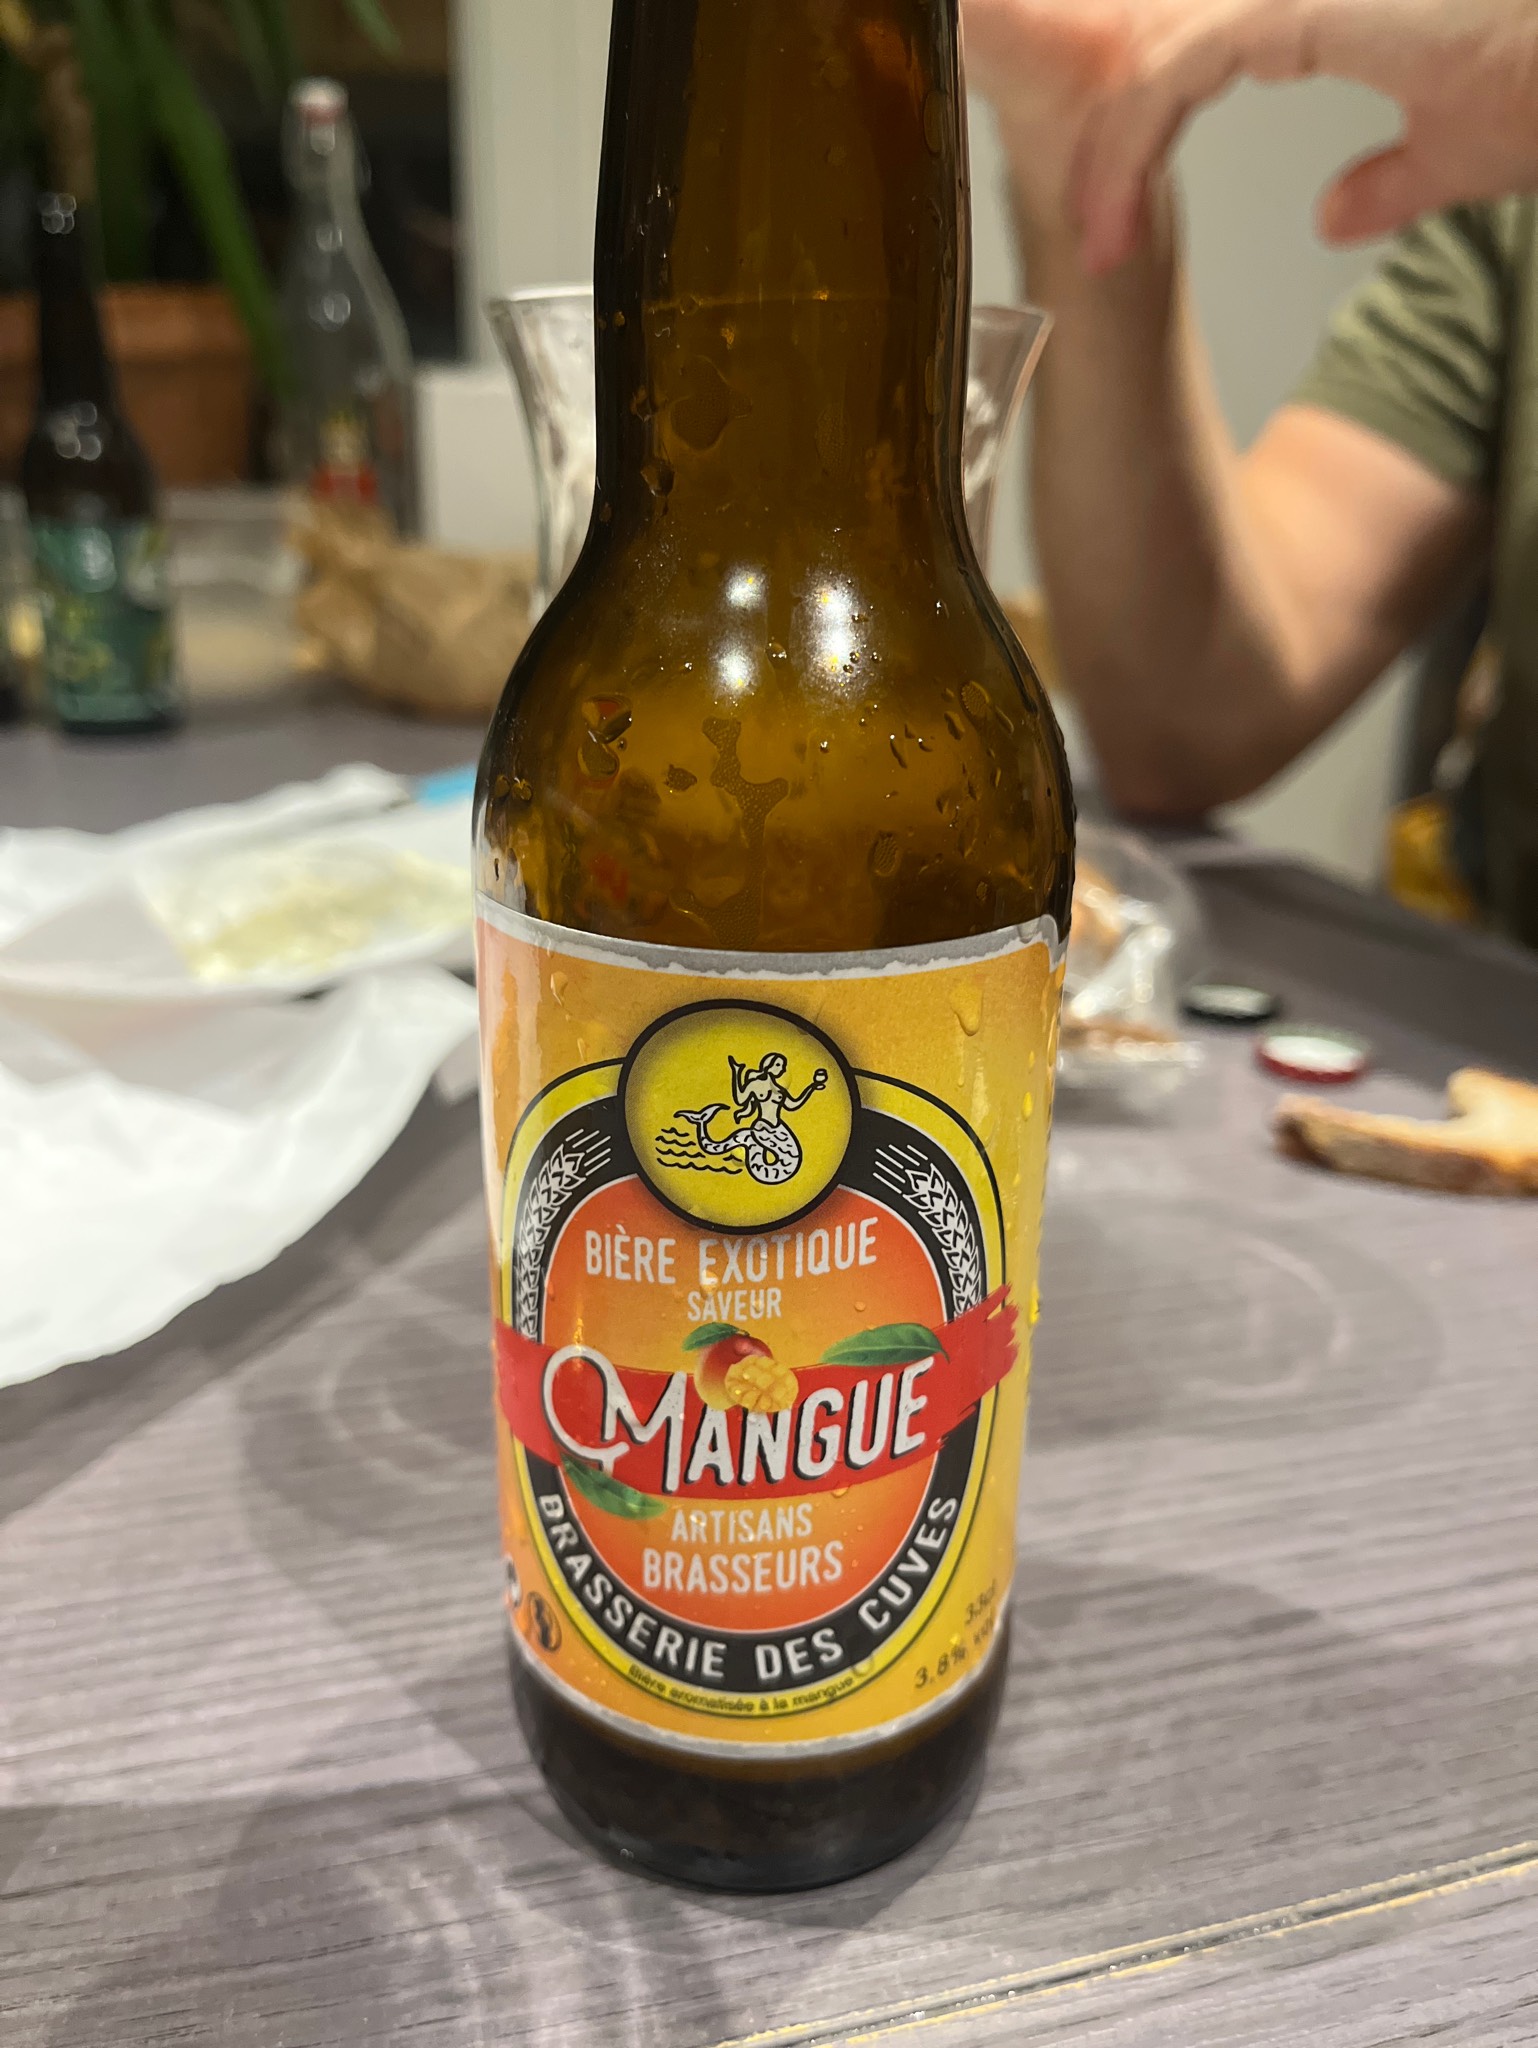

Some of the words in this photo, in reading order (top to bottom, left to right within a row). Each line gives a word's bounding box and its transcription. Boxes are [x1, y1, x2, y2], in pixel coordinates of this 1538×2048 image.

[585, 1223, 676, 1284] BIÈRE
[699, 1217, 879, 1286] EXOTIQUE
[687, 1287, 782, 1322] SAVEUR
[542, 1344, 935, 1495] MANGUE
[671, 1502, 813, 1545] ARTISANS
[537, 1494, 728, 1680] BRASSERIE
[754, 1627, 844, 1683] DES
[857, 1495, 958, 1632] CUVES
[642, 1541, 844, 1595] BRASSEURS
